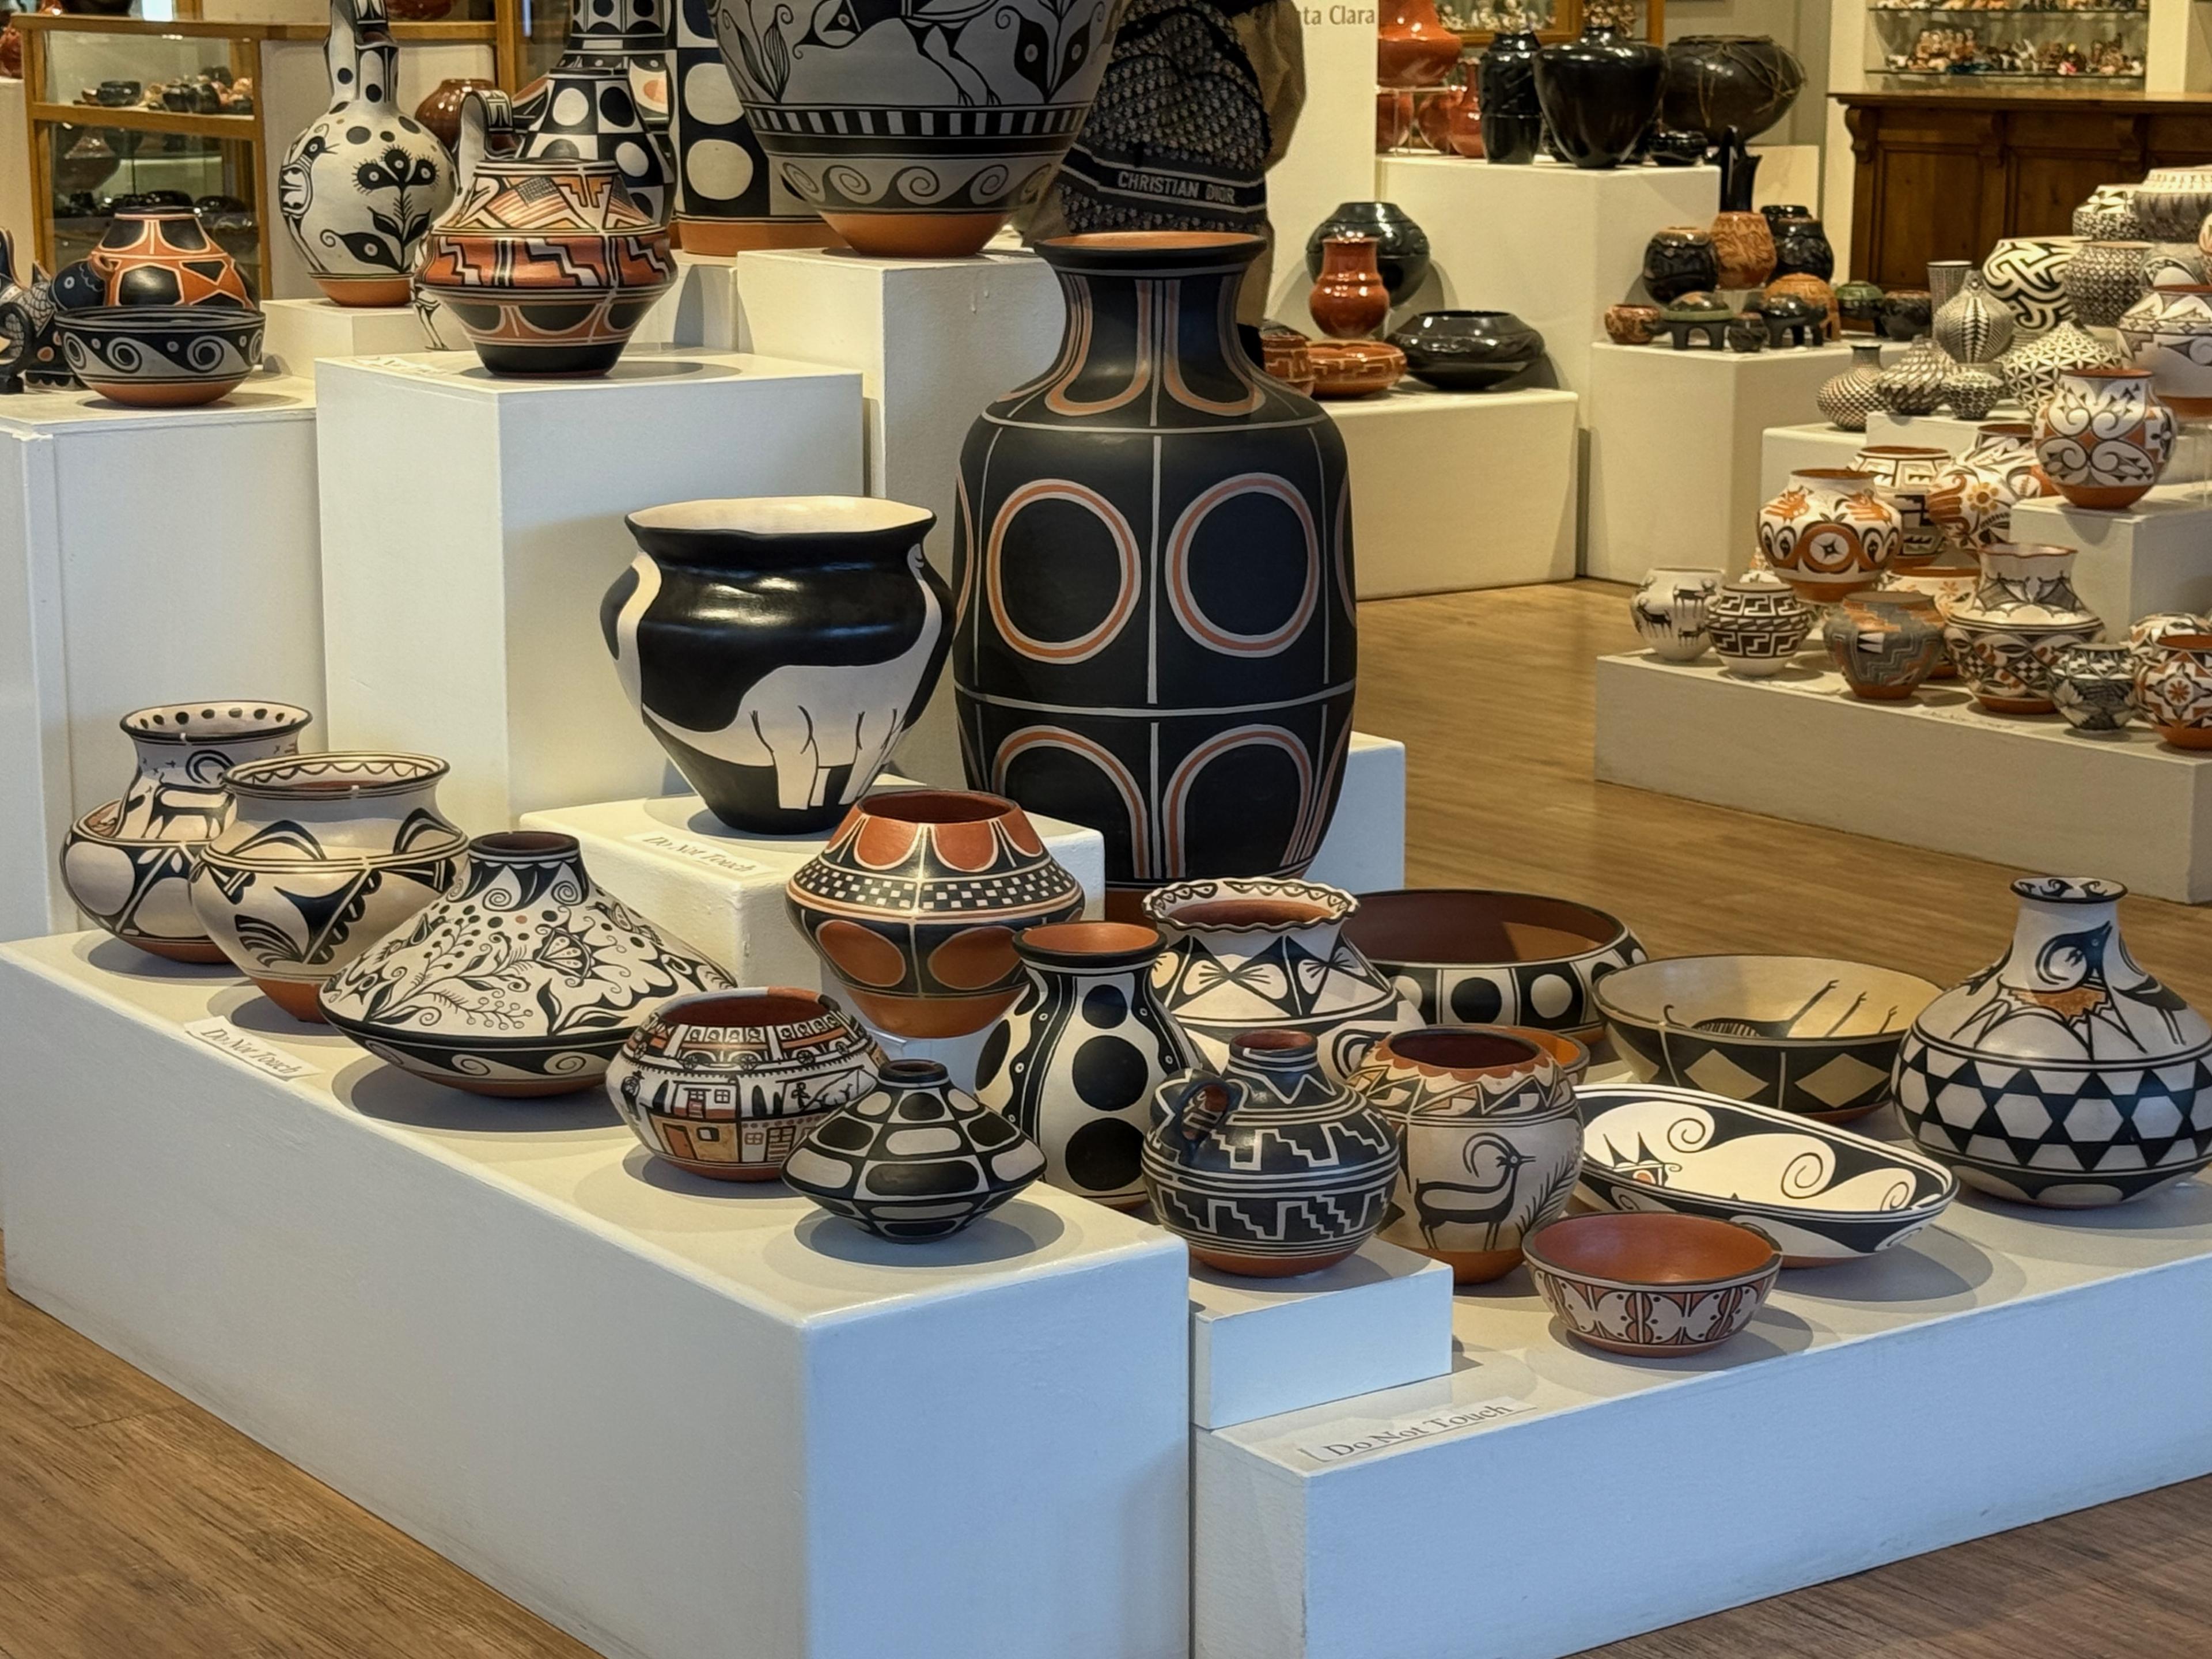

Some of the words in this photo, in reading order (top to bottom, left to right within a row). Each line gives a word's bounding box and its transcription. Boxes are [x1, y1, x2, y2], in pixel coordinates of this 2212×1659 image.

[1302, 6, 1321, 25] ta
[1329, 5, 1375, 25] Clara
[1118, 171, 1199, 198] CHRISTIAN
[1206, 184, 1235, 204] DIOR
[642, 836, 674, 849] Do
[700, 853, 756, 872] Touch
[200, 1028, 230, 1044] Do
[230, 1039, 257, 1054] Not
[252, 1052, 302, 1074] Touch
[1322, 1441, 1372, 1457] Do
[1370, 1426, 1429, 1444] Not
[1423, 1404, 1512, 1429] Touch
